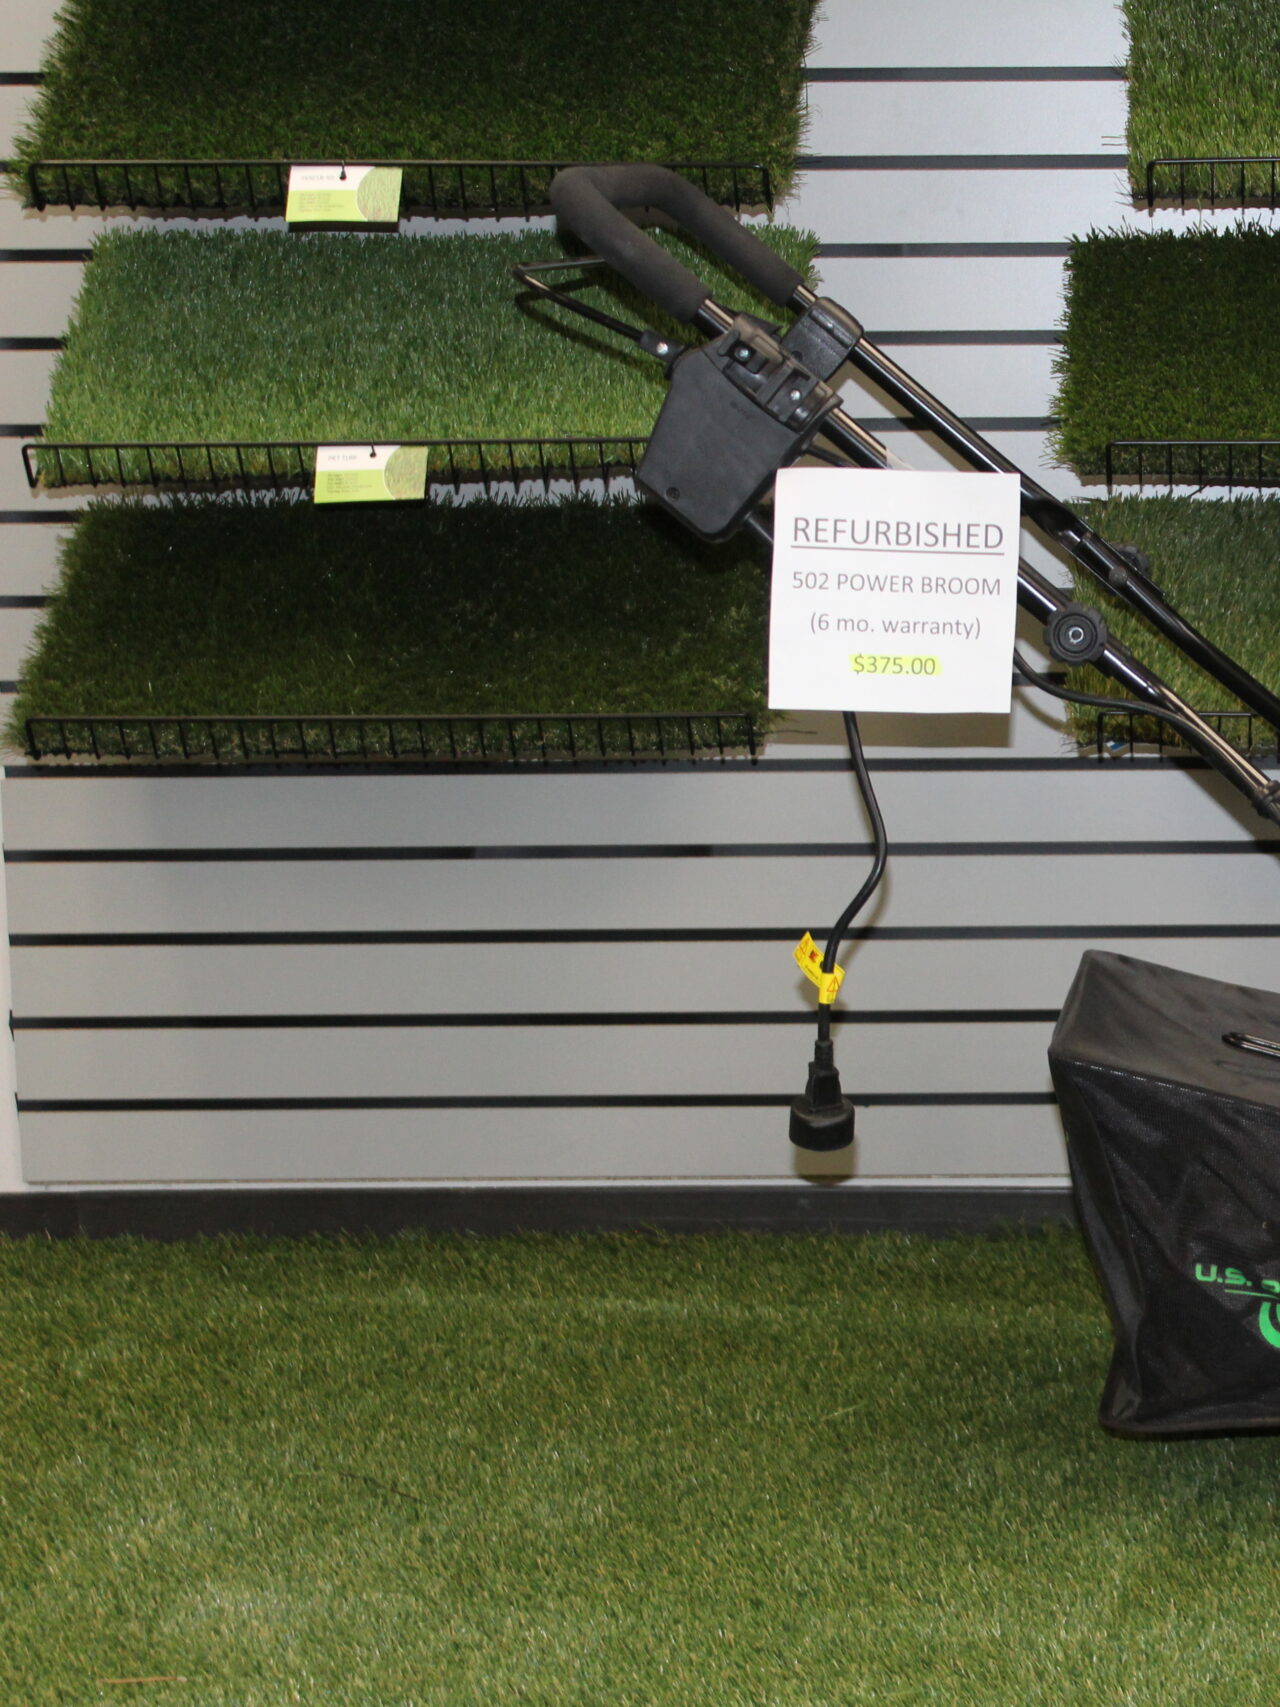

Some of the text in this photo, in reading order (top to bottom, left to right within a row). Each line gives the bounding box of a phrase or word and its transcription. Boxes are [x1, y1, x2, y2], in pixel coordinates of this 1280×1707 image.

[793, 516, 1005, 550] REFURBISHED
[792, 571, 1001, 596] 502 POWER BROOM
[810, 612, 982, 640] (6 mo. warranty)
[853, 653, 936, 676] $375.00
[1195, 1263, 1254, 1287] U.S.
